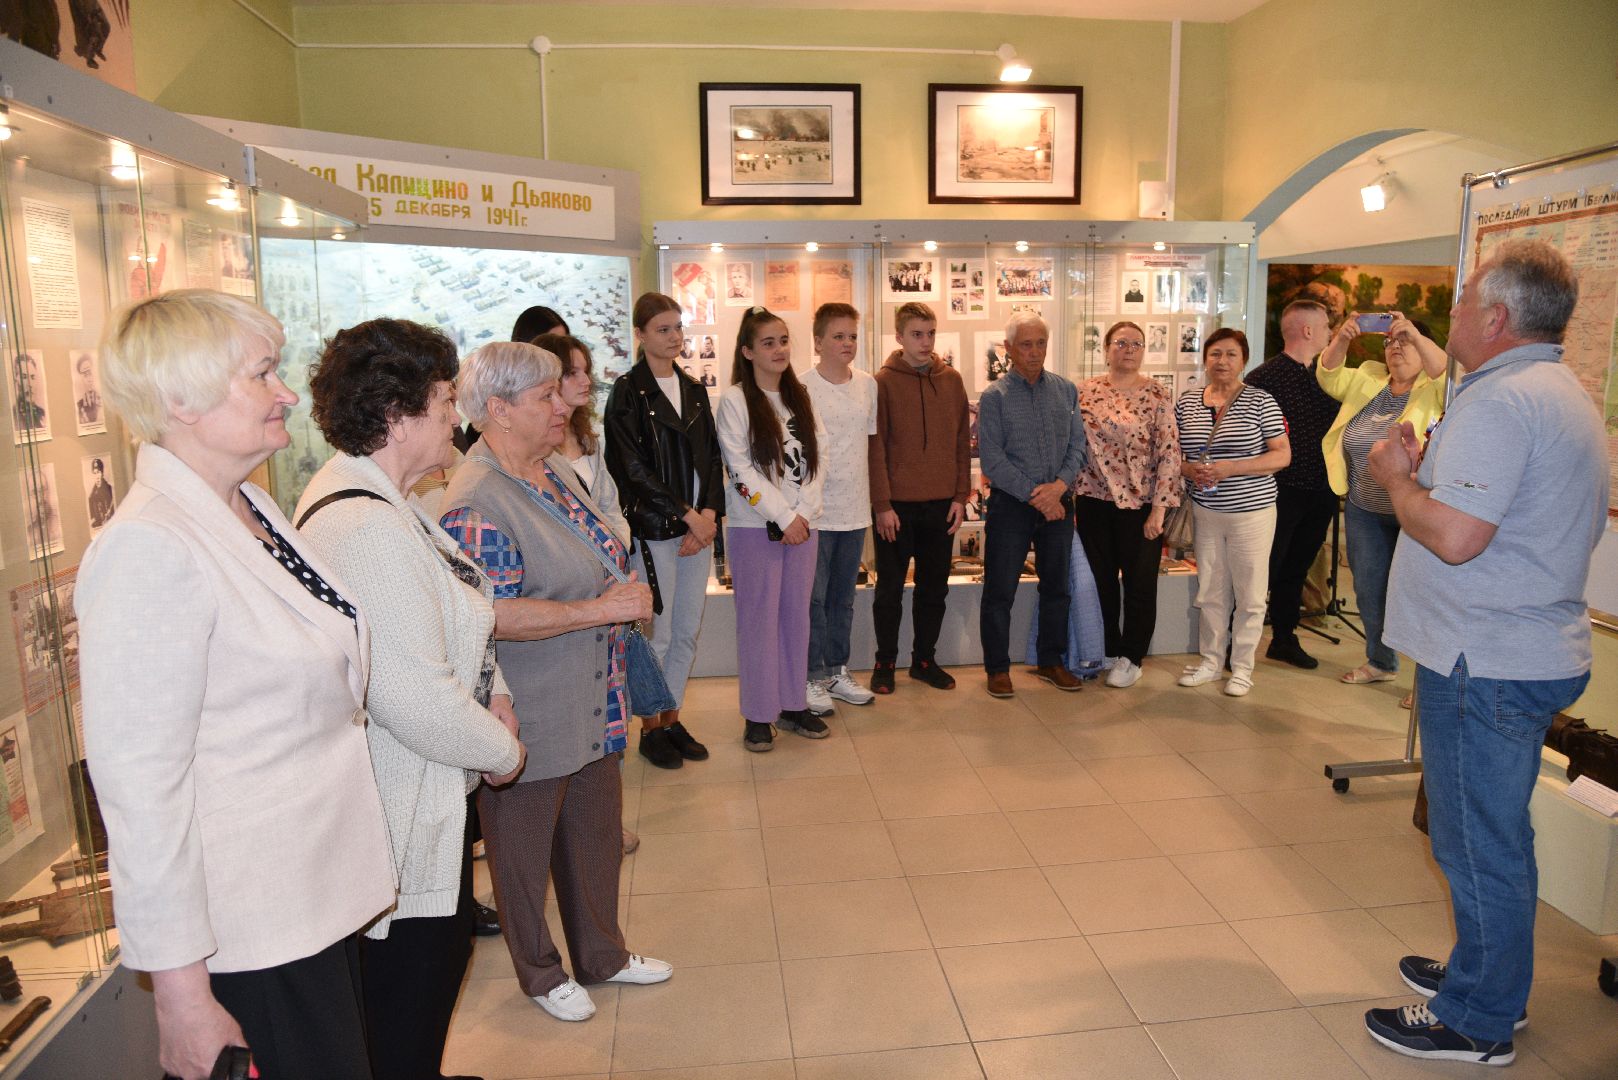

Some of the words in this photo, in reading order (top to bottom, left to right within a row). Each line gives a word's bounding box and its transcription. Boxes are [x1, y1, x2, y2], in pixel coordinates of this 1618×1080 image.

[394, 199, 471, 219] ДЕКАБРЯ
[1478, 204, 1530, 225] ПОСЛЕДНИЙ
[1538, 197, 1578, 215] ШТУРМ
